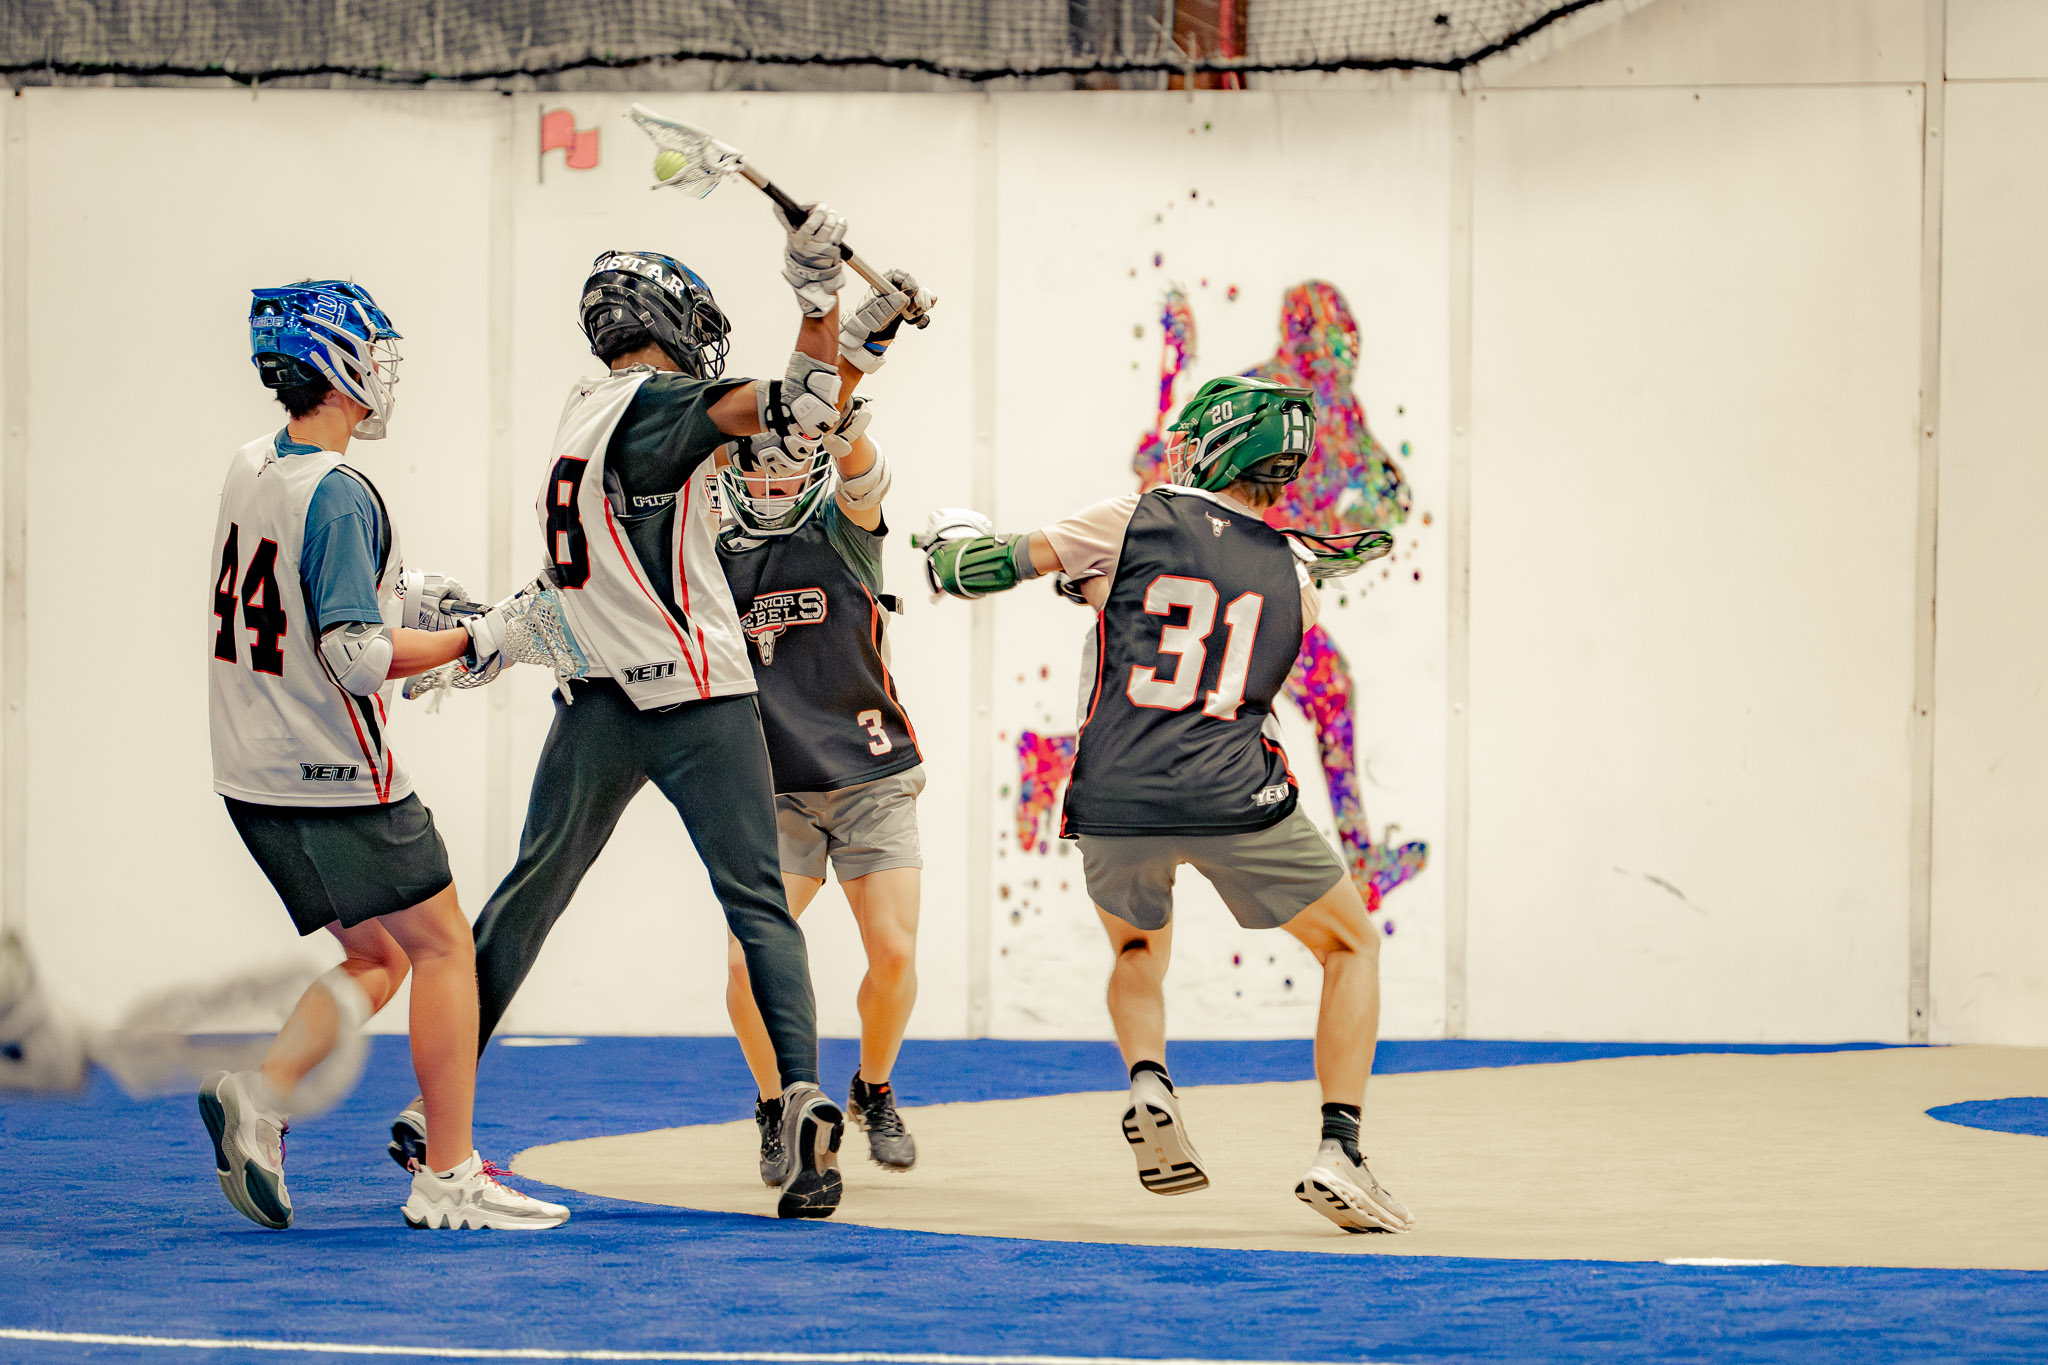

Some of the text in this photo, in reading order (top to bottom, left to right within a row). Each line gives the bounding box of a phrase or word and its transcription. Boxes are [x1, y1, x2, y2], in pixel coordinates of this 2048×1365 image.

[313, 294, 347, 327] 21
[1210, 400, 1234, 426] 20
[213, 521, 288, 678] 44
[1126, 574, 1265, 722] 31
[620, 659, 678, 685] YETI
[856, 708, 893, 757] 3
[299, 762, 360, 782] YETI
